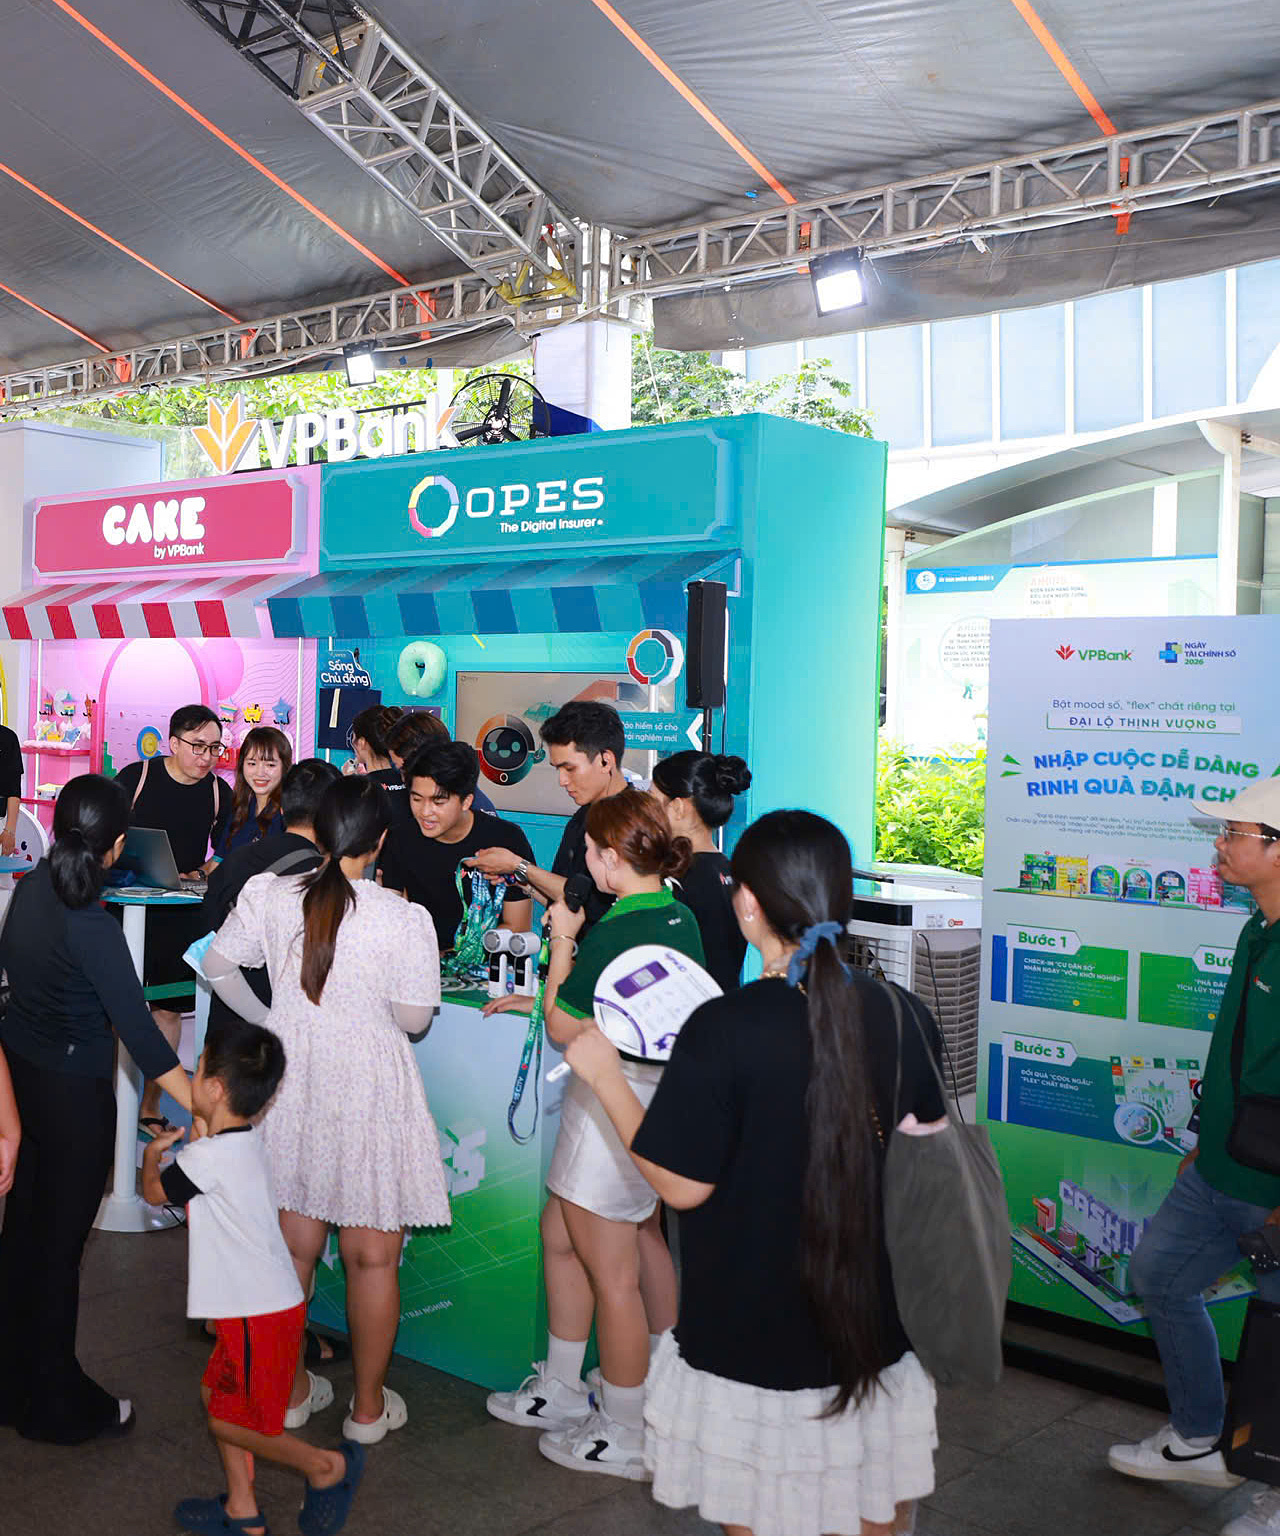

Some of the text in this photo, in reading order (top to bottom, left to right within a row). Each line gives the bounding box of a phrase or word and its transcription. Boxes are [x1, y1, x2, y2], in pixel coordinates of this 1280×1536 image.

[260, 394, 462, 468] VPBank
[465, 477, 605, 518] OPES
[102, 496, 206, 546] CAKE
[500, 518, 596, 534] The Digital Insurer
[153, 541, 205, 560] by VPBank
[1184, 641, 1207, 649] NGÀY
[1185, 648, 1236, 658] TÀI CHÍNH SỐ
[1077, 649, 1133, 662] VPBank
[1184, 658, 1204, 666] 2026
[329, 659, 354, 674] Sống
[321, 670, 369, 687] Chủ động
[1052, 699, 1071, 711] Bật
[1074, 700, 1105, 710] mood
[1187, 701, 1217, 714] riêng
[1220, 703, 1236, 714] tại
[664, 723, 679, 731] cho
[1069, 715, 1217, 731] ĐẠI LỘ THỊNH VƯỢNG
[1033, 748, 1260, 779] NHẬP CUỘC DỄ DÀNG
[1026, 778, 1079, 798] RINH
[1084, 775, 1135, 796] QUÀ
[1140, 777, 1195, 801] ĐẬM
[1018, 931, 1067, 948] Bước 1
[1023, 957, 1054, 967] CHECK-IN
[1014, 1039, 1066, 1059] Bước 3
